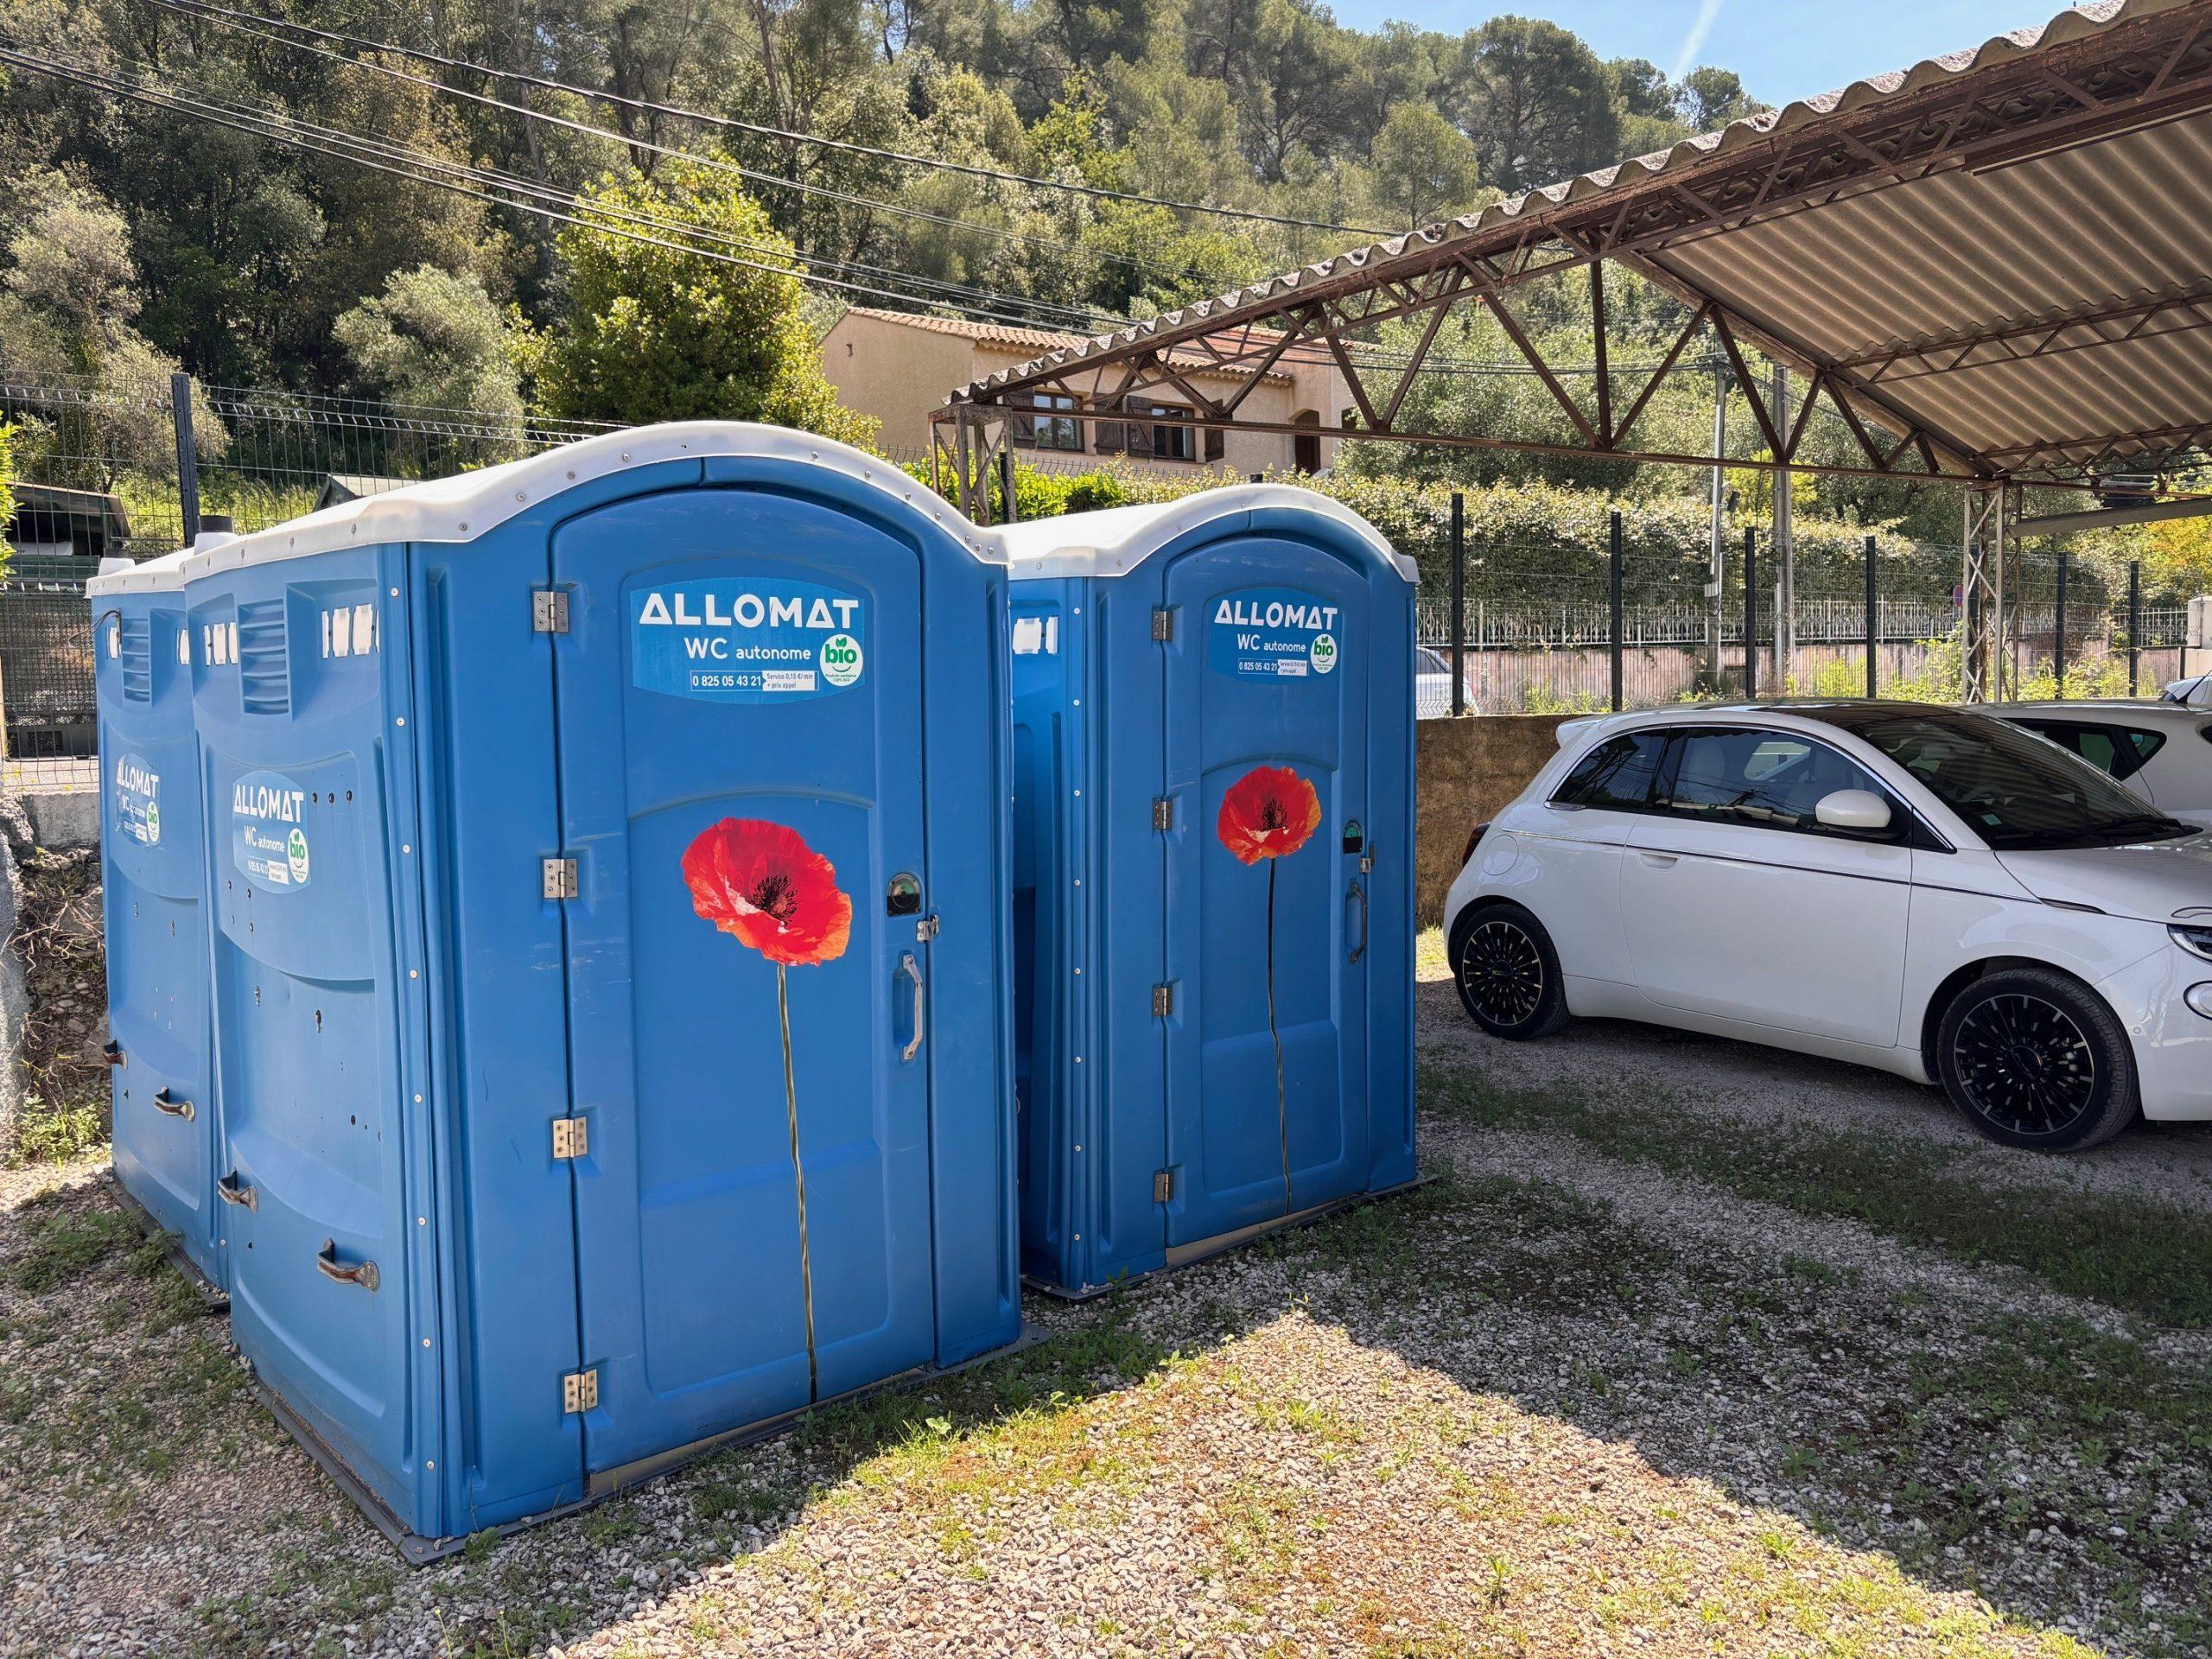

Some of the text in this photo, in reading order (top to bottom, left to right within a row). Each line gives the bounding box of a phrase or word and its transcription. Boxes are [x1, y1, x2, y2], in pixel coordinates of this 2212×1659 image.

[639, 593, 859, 629] ALLOMAT
[1214, 600, 1338, 631] ALLOMAT
[684, 638, 811, 660] WC autonome
[824, 644, 857, 664] bio
[1237, 633, 1306, 653] WC autonome
[1313, 641, 1334, 657] bio
[1244, 662, 1254, 671] 825
[1263, 662, 1270, 671] 43
[1271, 663, 1277, 671] 21
[692, 675, 761, 687] 0 825 05 43 21
[117, 762, 159, 798] ALLOMAT
[234, 784, 304, 823] ALLOMAT
[244, 825, 285, 853] WC autonome
[289, 837, 306, 860] bio
